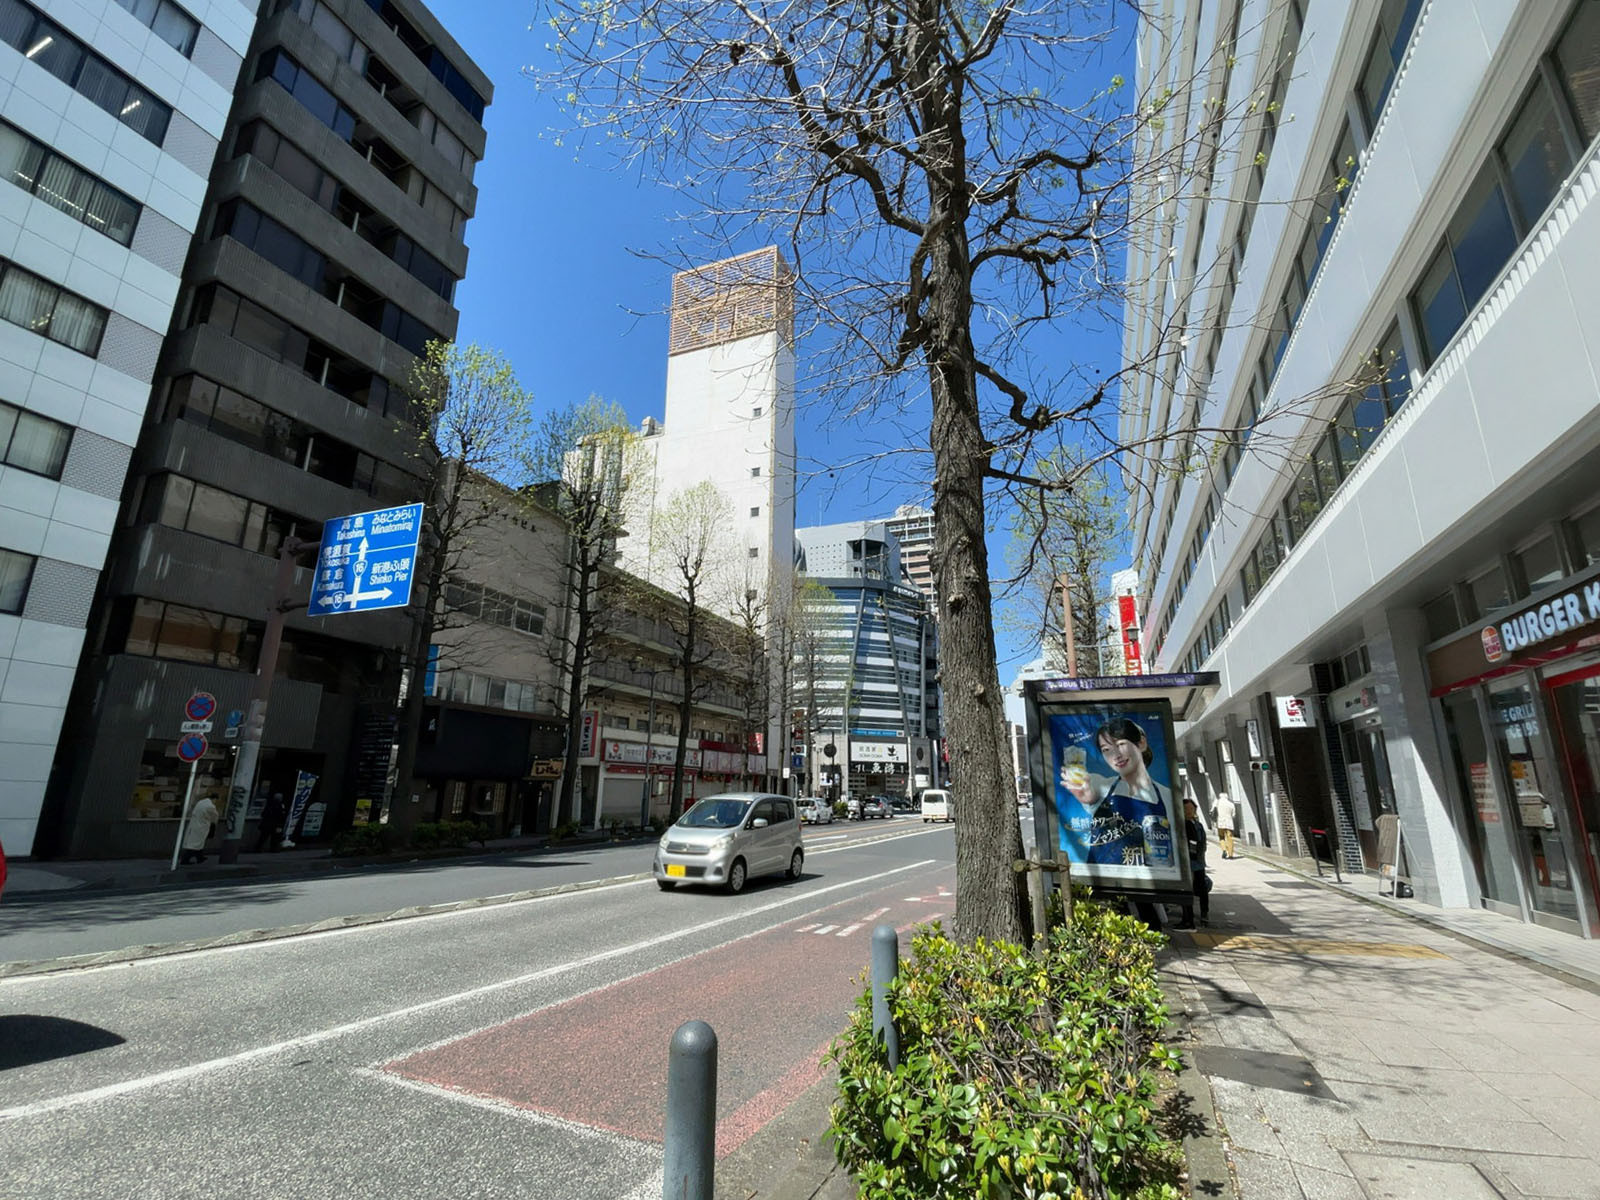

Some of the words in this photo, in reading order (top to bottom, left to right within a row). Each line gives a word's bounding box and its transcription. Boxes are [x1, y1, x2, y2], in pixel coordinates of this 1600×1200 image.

[342, 516, 364, 530] 高島
[372, 508, 416, 524] みなとみらい
[370, 519, 414, 535] Minatomirai
[336, 529, 366, 541] Takashima
[355, 562, 364, 572] 16
[371, 558, 410, 574] 新港ふ頭
[370, 574, 392, 585] Shinko
[394, 572, 409, 582] Pier
[334, 594, 343, 604] 16
[1501, 593, 1584, 652] BURGER
